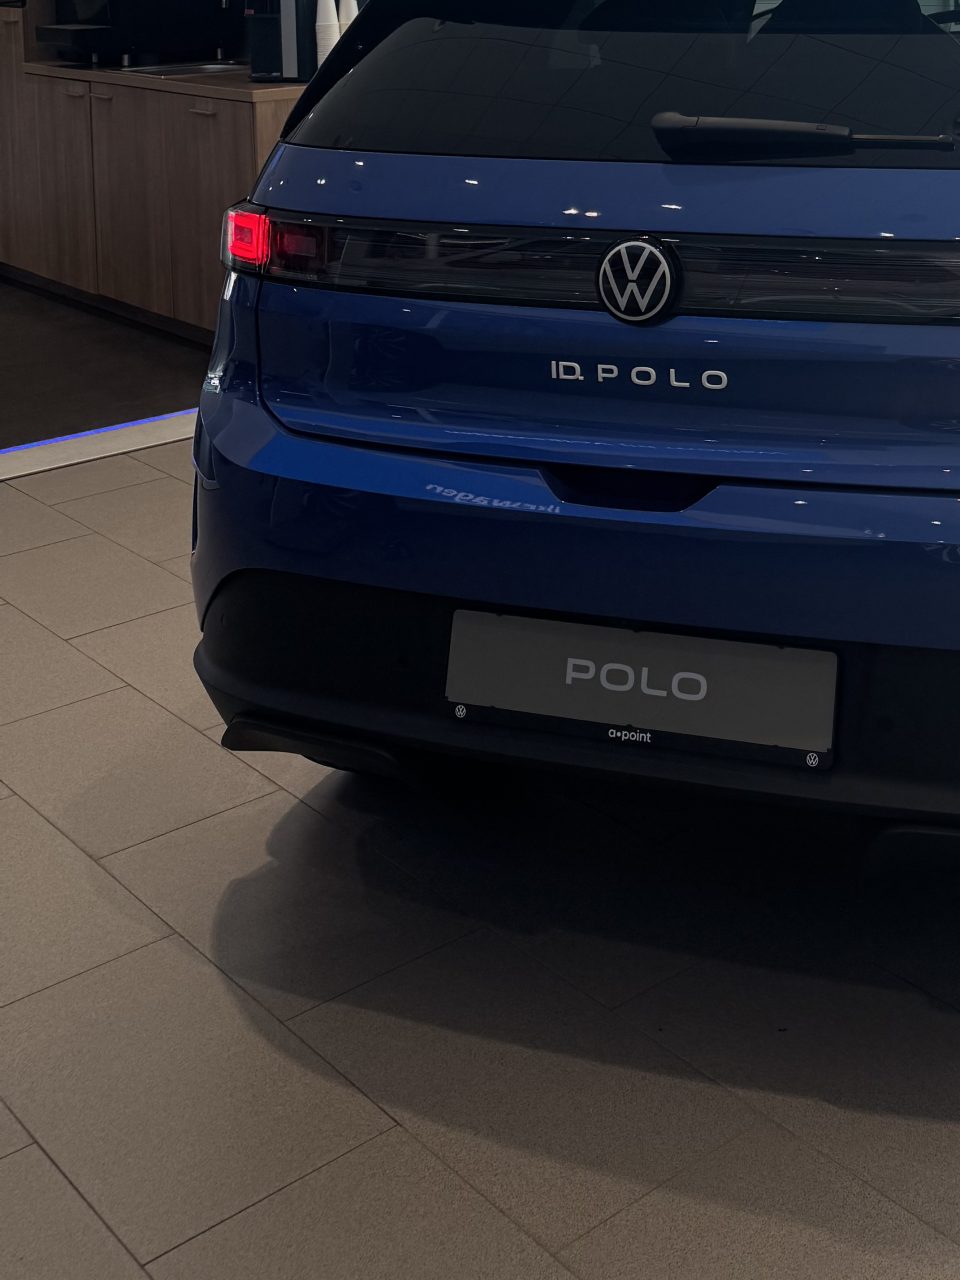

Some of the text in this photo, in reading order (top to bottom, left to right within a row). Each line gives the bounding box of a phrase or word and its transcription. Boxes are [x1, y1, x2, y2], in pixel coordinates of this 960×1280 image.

[600, 242, 670, 319] VW
[597, 364, 728, 390] POLO
[565, 657, 708, 701] POLO
